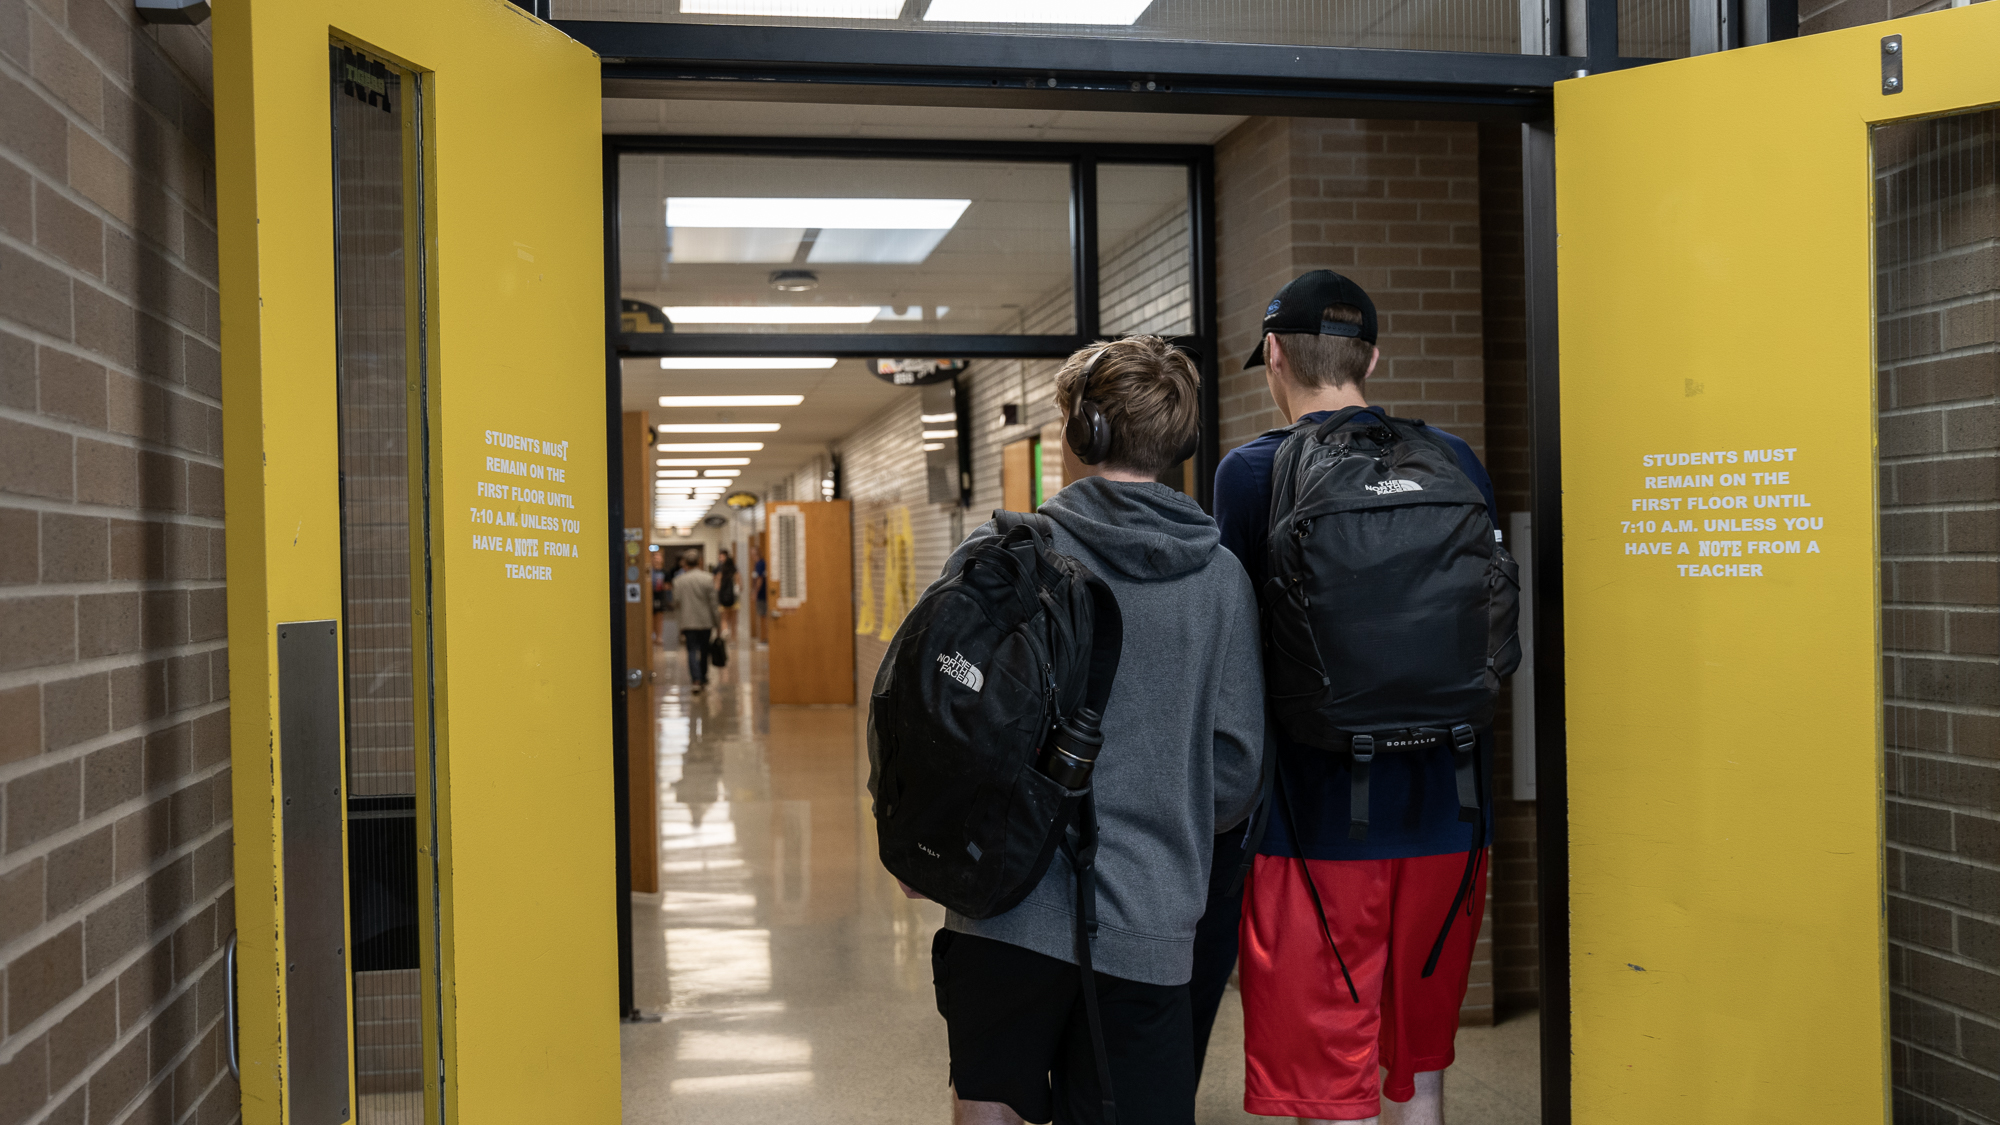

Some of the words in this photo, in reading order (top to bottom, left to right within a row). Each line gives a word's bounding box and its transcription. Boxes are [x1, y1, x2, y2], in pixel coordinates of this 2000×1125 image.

[485, 429, 540, 454] STUDENTS
[542, 440, 569, 461] MUST
[1643, 450, 1738, 467] STUDENTS
[1743, 447, 1797, 463] MUST
[486, 456, 527, 477] REMAIN
[529, 464, 544, 480] ON
[546, 466, 565, 483] THE
[1364, 484, 1401, 492] NORTH
[1378, 479, 1399, 487] THE
[1645, 474, 1714, 489] REMAIN
[1719, 473, 1746, 487] ON
[1752, 471, 1790, 485] THE
[477, 481, 509, 500] FIRST
[511, 486, 545, 505] FLOOR
[547, 491, 575, 509] UNTIL
[1632, 498, 1682, 511] FIRST
[1687, 496, 1748, 510] FLOOR
[1753, 494, 1811, 508] UNTIL
[470, 507, 493, 525] 7:10
[496, 511, 518, 527] A.M.
[521, 513, 559, 531] UNLESS
[561, 518, 580, 534] YOU
[1620, 520, 1656, 533] 7:10
[1661, 519, 1698, 533] A.M.
[1703, 518, 1777, 532] UNLESS
[1783, 516, 1824, 531] YOU
[472, 534, 503, 551] HAVE
[505, 537, 513, 552] A
[514, 538, 539, 557] NOTE
[544, 541, 570, 558] FROM
[572, 544, 579, 558] A
[1624, 542, 1672, 555] HAVE
[1677, 542, 1690, 555] A
[1698, 540, 1742, 557] NOTE
[1747, 540, 1801, 554] FROM
[1806, 540, 1820, 554] A
[505, 563, 552, 581] TEACHER
[1677, 564, 1763, 577] TEACHER
[936, 653, 968, 676] NORTH
[955, 651, 972, 670] THE
[939, 664, 965, 683] FACE
[1386, 737, 1436, 747] BOREALIS
